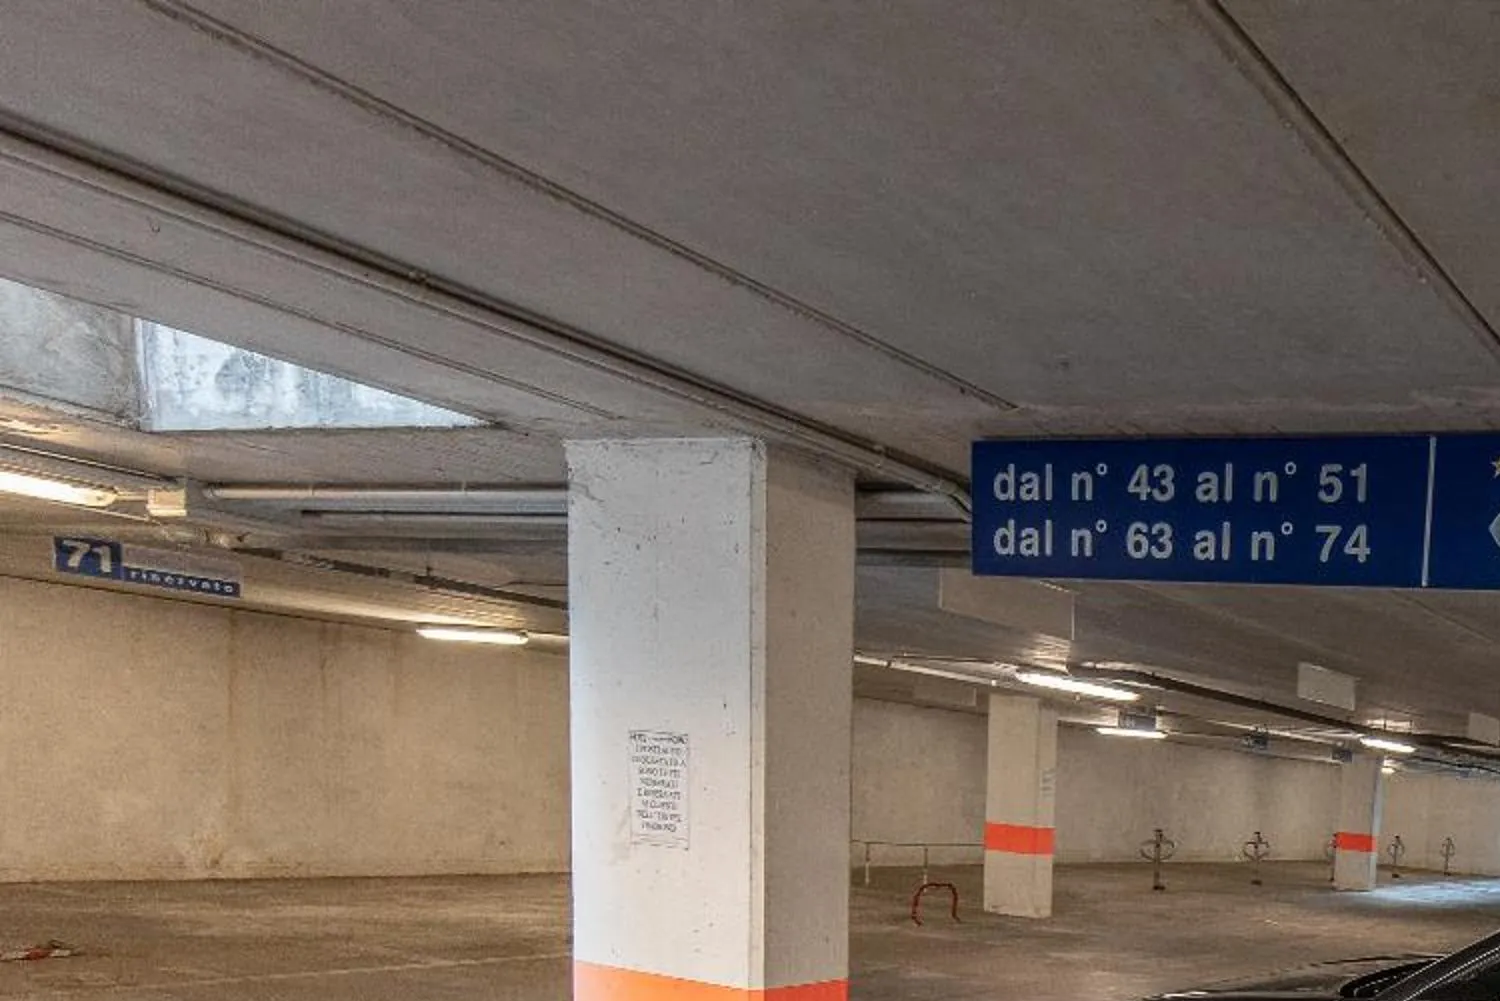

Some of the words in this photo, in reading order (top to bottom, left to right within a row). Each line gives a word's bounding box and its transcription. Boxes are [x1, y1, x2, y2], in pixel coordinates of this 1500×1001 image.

[993, 463, 1053, 502] dal
[1127, 464, 1175, 502] 43
[1195, 463, 1233, 502] al
[1318, 463, 1368, 503] 51
[62, 539, 113, 573] 71
[993, 519, 1053, 557] dal
[1126, 522, 1174, 559] 63
[1193, 521, 1231, 561] al
[1315, 525, 1372, 563] 74
